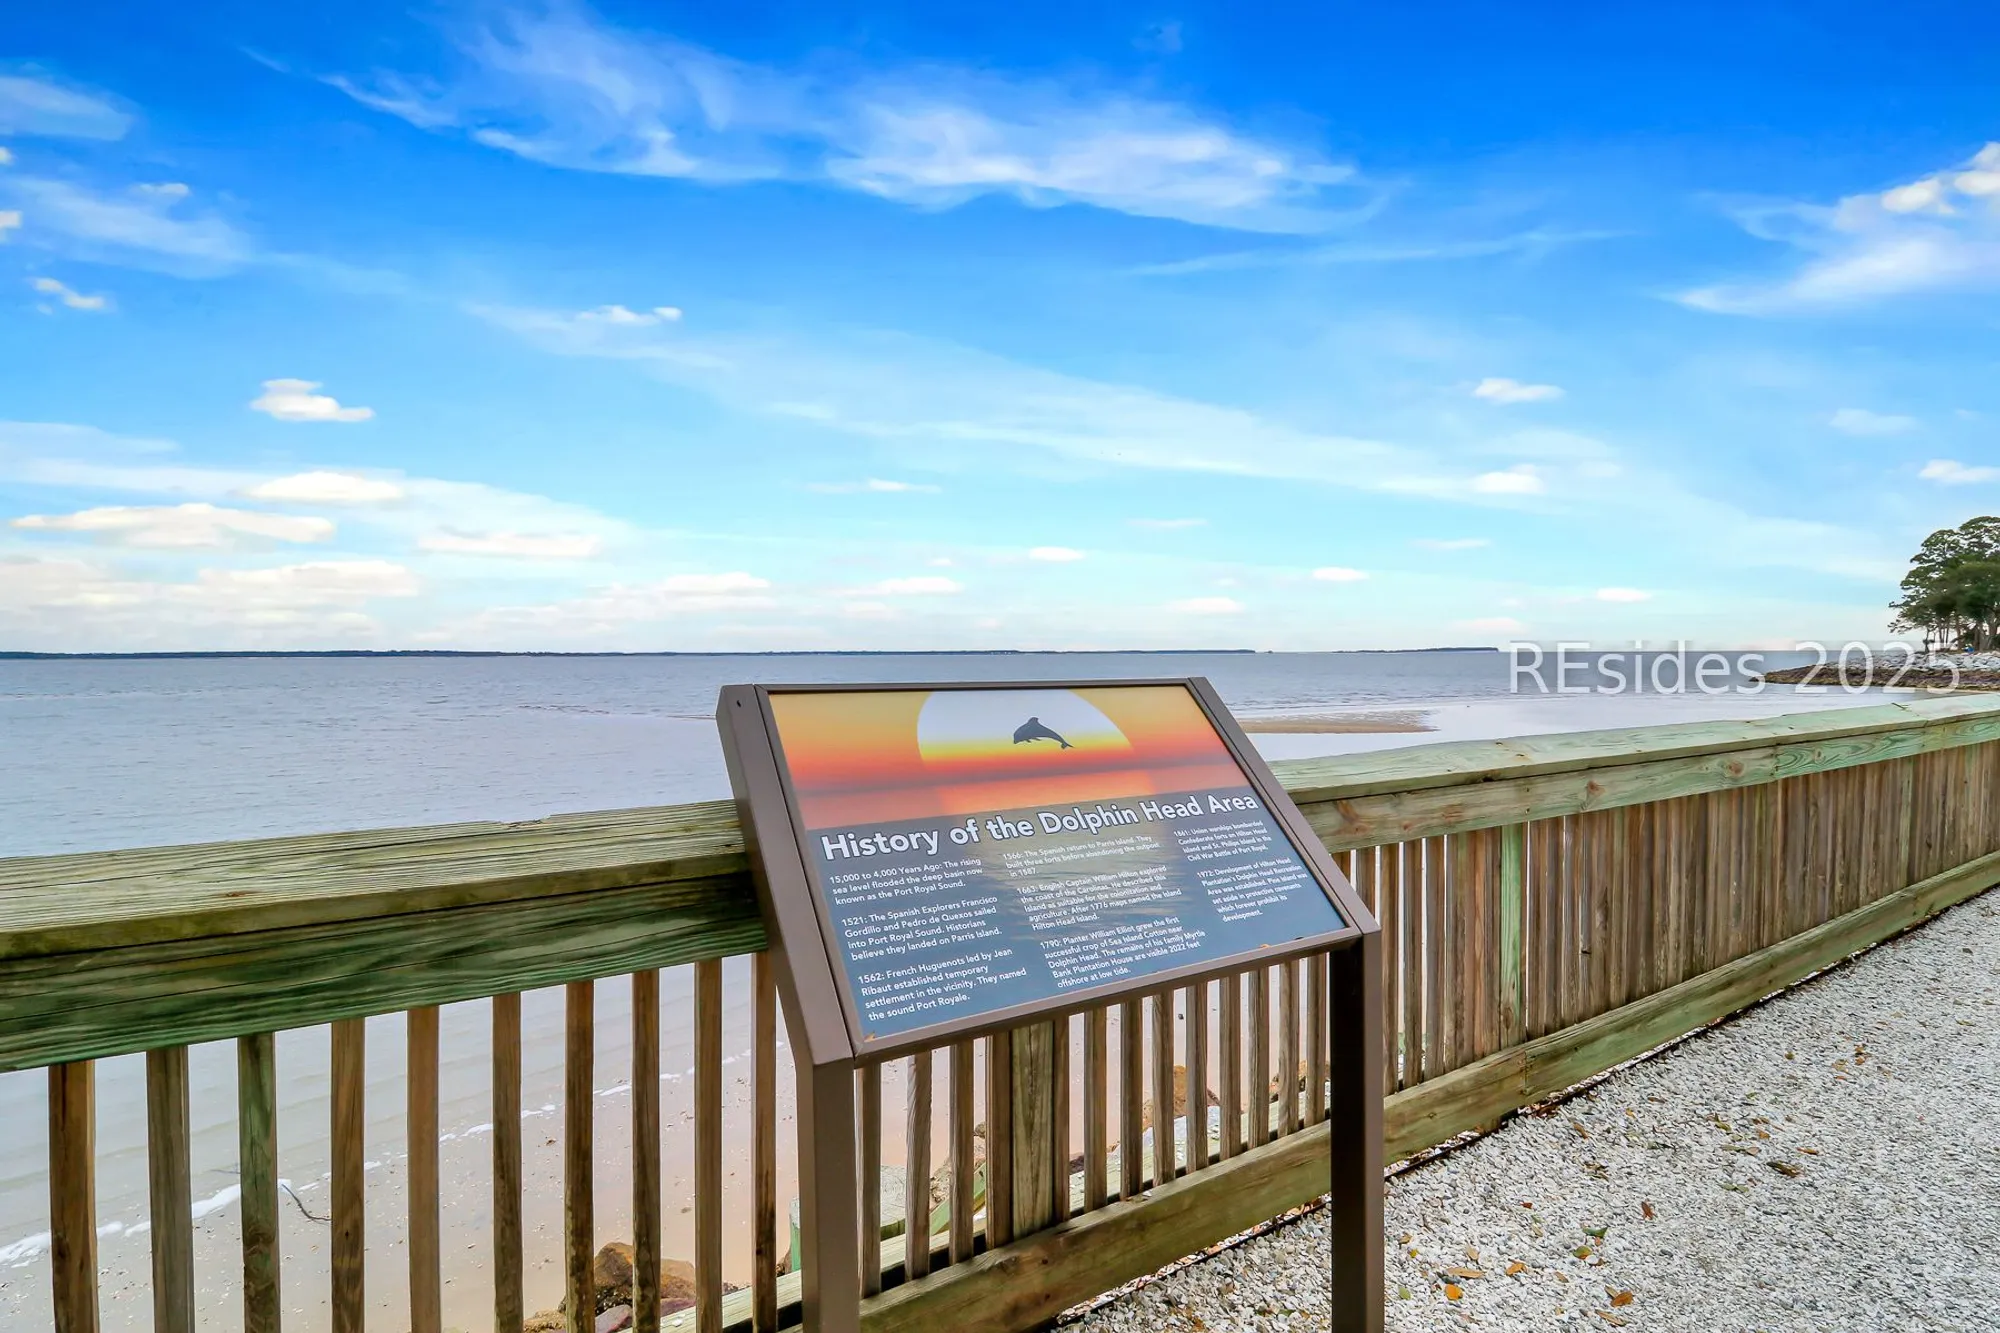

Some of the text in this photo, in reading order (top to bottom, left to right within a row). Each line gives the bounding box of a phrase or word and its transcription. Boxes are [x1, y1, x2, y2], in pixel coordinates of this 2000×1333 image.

[820, 793, 1259, 861] History of the Dolphin Head Area
[1006, 861, 1024, 869] built
[1039, 847, 1066, 857] Spanish
[829, 874, 860, 884] 15,000
[873, 869, 897, 879] 4,000
[923, 865, 943, 873] Ago:
[849, 883, 870, 892] level
[872, 879, 906, 889] flooded
[944, 871, 965, 879] basin
[1039, 882, 1065, 892] English
[1065, 878, 1093, 888] Captain
[1092, 875, 1118, 883] William
[1139, 867, 1168, 876] explored
[835, 897, 865, 905] known
[894, 889, 914, 897] Port
[914, 885, 937, 895] Royal
[938, 881, 966, 890] Sound.
[1035, 893, 1055, 901] coast
[1122, 877, 1155, 887] described
[842, 898, 998, 927] 1521: The Spanish Explorers Francisco
[1024, 903, 1047, 912] Island
[1028, 911, 1069, 923] agriculture.
[1090, 902, 1109, 911] 1776
[1162, 890, 1183, 898] Island
[844, 926, 882, 938] Gordillo
[883, 923, 900, 932] and
[902, 920, 927, 929] Pedro
[941, 913, 973, 922] Quexos
[974, 907, 997, 917] sailed
[848, 921, 986, 949] into Port Royal Sound. Historians
[1031, 914, 1100, 931] Hilton Head Island.
[851, 950, 885, 960] believe
[886, 946, 907, 954] they
[907, 939, 938, 950] landed
[951, 933, 975, 943] Parris
[976, 928, 1002, 938] Island.
[1040, 940, 1063, 950] 1790:
[1063, 936, 1090, 945] Planter
[1089, 931, 1117, 940] William
[1044, 946, 1082, 959] successful
[1082, 944, 1100, 952] crop
[1122, 934, 1144, 943] Island
[1143, 931, 1168, 939] Cotton
[1048, 957, 1079, 969] Dolphin
[1078, 952, 1102, 962] Head.
[1117, 945, 1145, 955] remains
[1145, 941, 1154, 949] of
[1163, 936, 1186, 945] family
[858, 950, 1013, 984] 1562: French Huguenots led by Jean
[1052, 968, 1073, 978] Bank
[1072, 962, 1111, 974] Plantation
[1111, 957, 1134, 966] House
[1147, 949, 1169, 958] visible
[1168, 944, 1188, 954] 2022
[1186, 942, 1202, 950] feet
[861, 967, 990, 996] Ribaut established temporary
[865, 969, 1028, 1009] settlement in the vicinity. They named
[1057, 977, 1090, 988] offshore
[1090, 973, 1099, 981] at
[1113, 967, 1132, 976] tide.
[868, 994, 971, 1021] the sound Port Royale.
